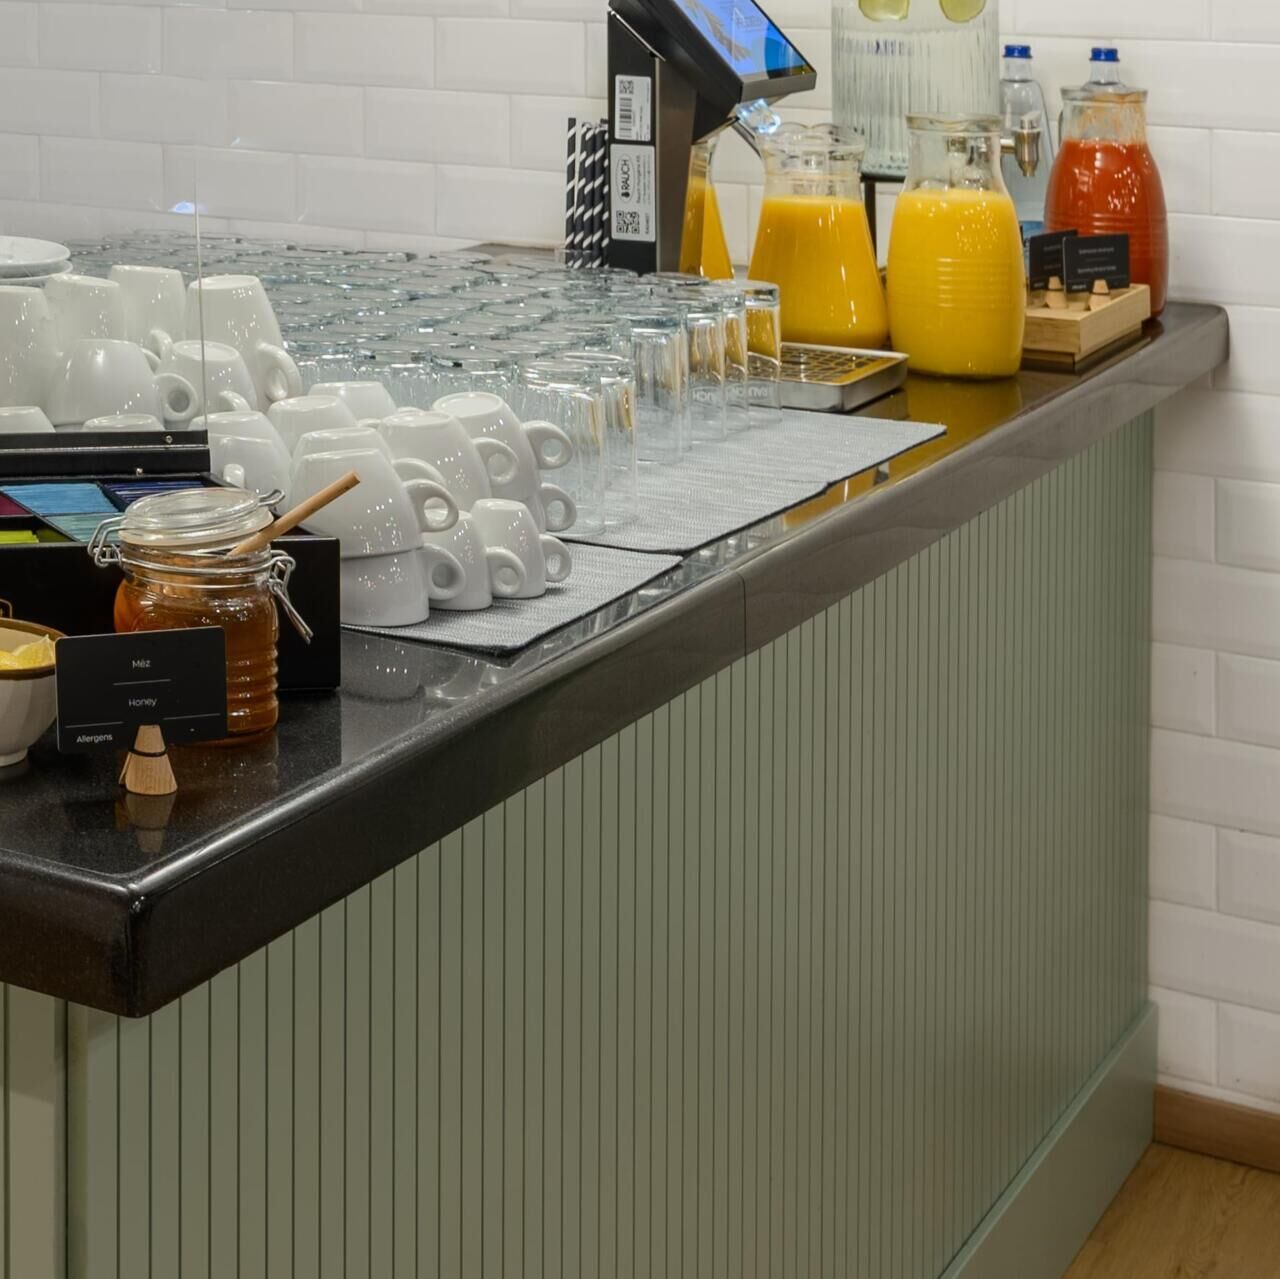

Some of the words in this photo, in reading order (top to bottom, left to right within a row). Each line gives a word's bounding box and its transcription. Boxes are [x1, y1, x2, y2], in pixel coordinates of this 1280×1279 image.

[621, 159, 631, 191] RAUCH
[132, 659, 151, 669] Méz
[128, 698, 157, 707] Honey
[76, 733, 113, 744] Allergens
